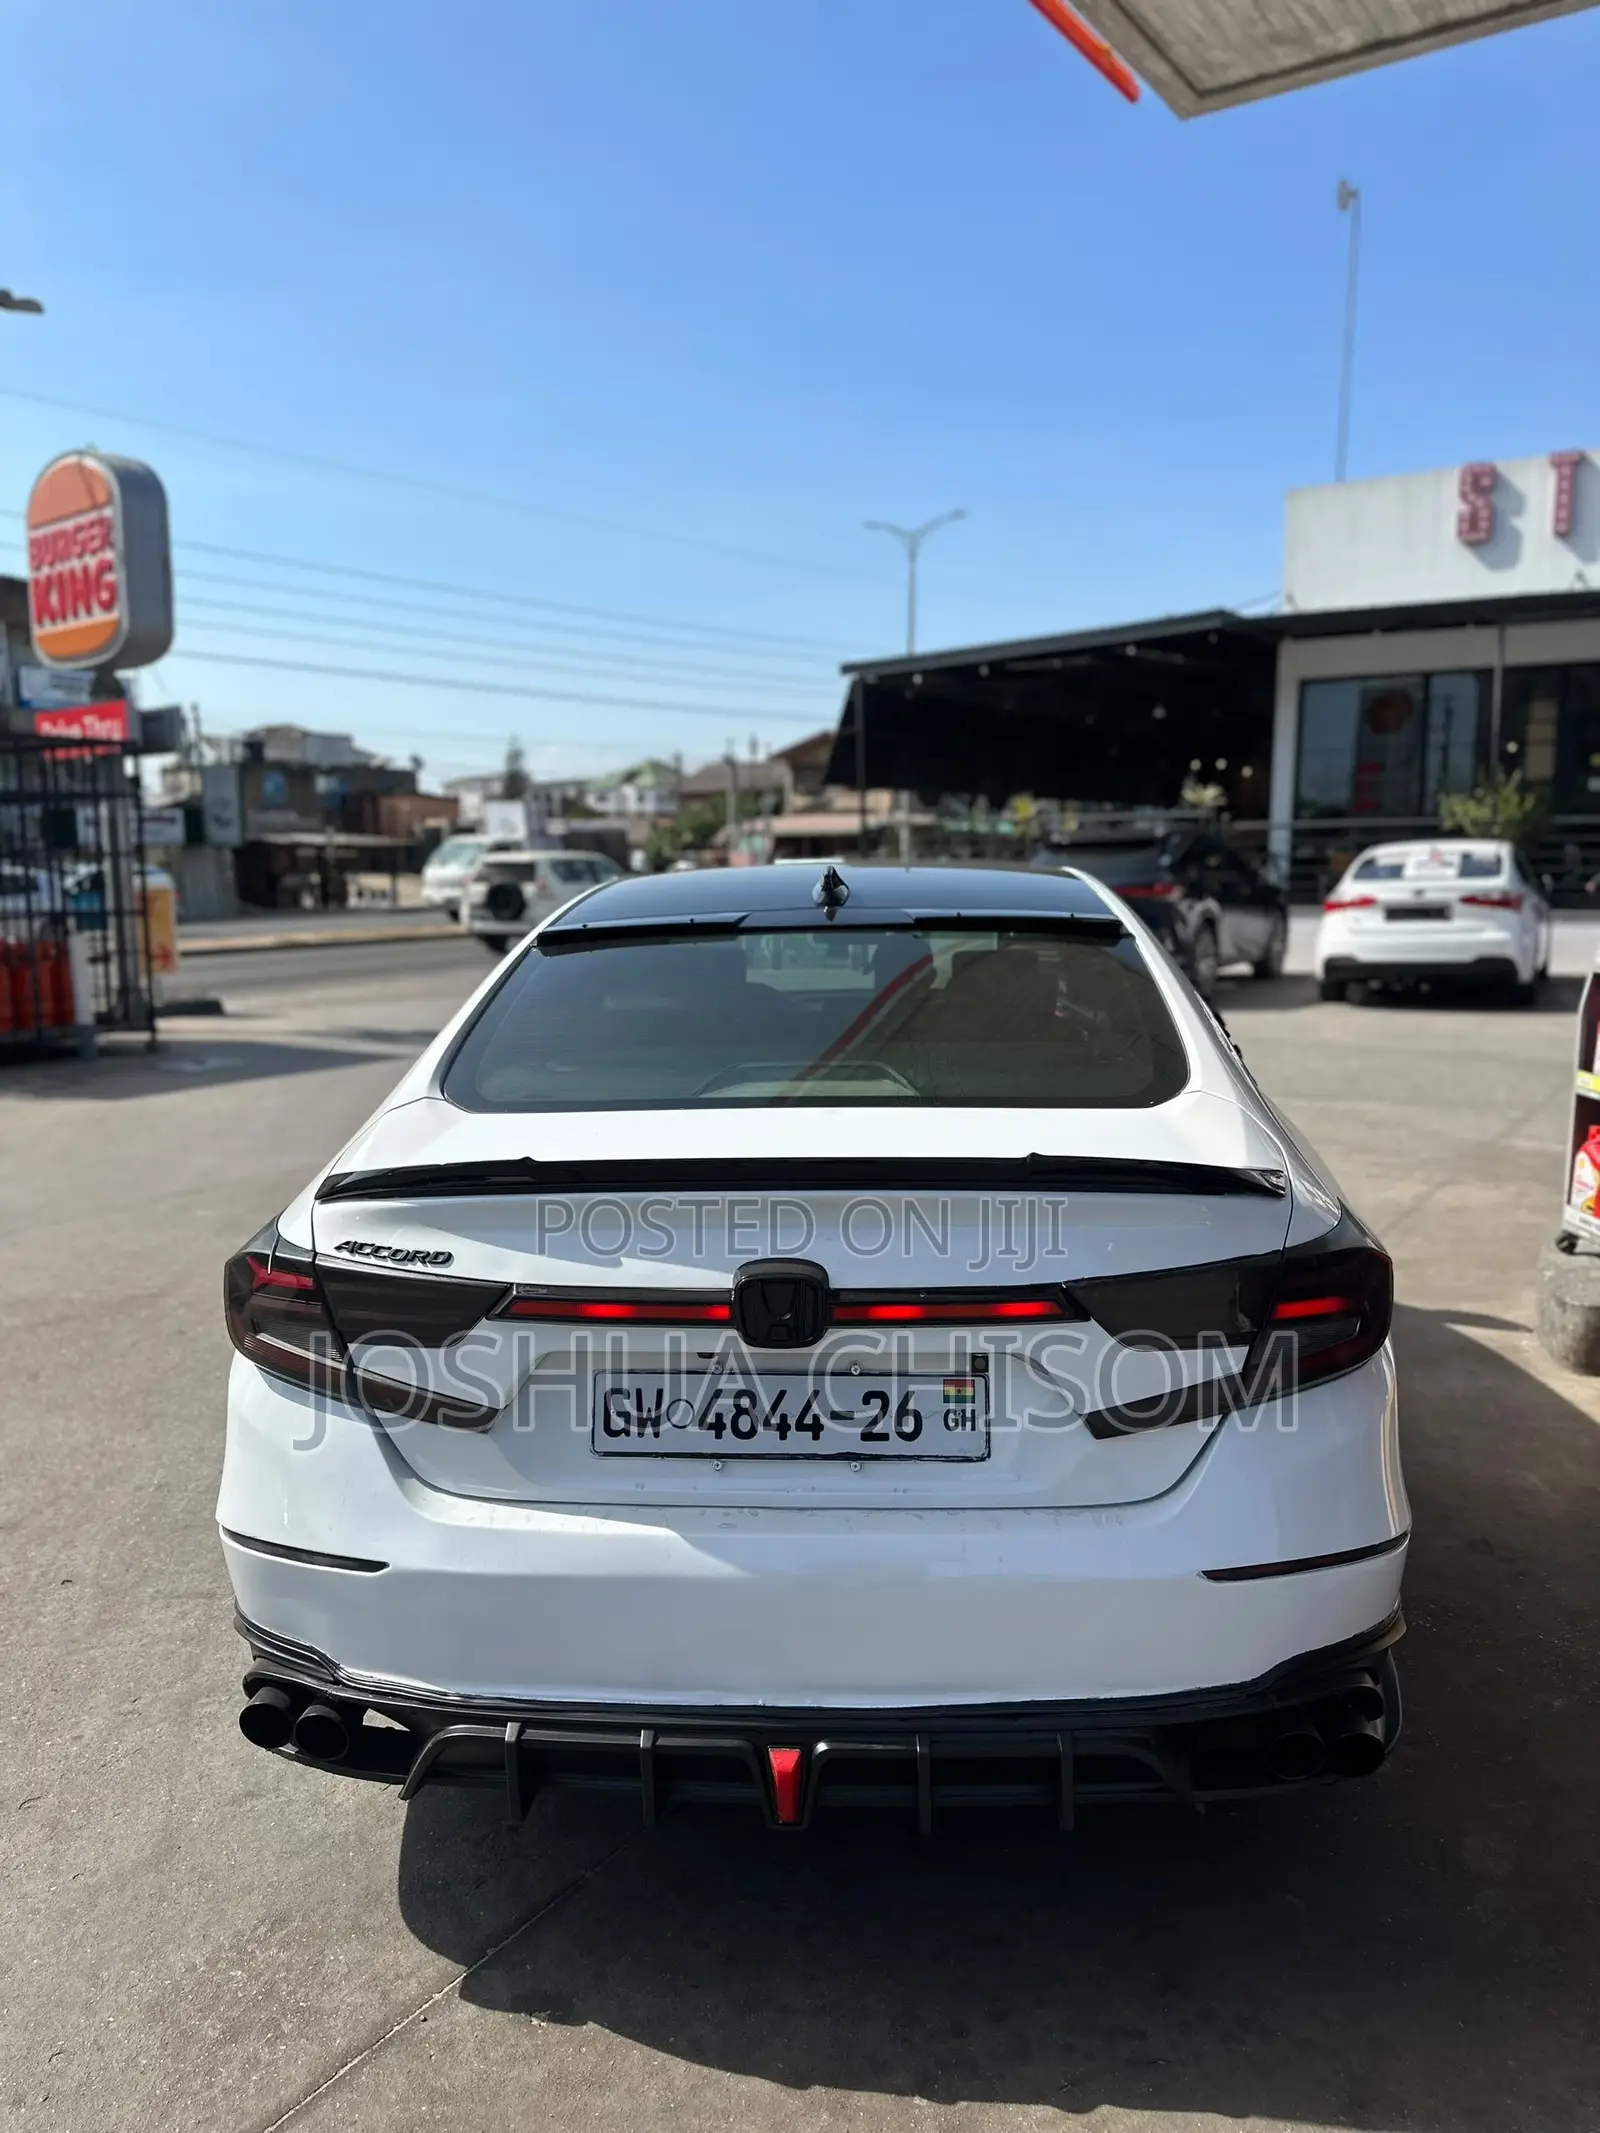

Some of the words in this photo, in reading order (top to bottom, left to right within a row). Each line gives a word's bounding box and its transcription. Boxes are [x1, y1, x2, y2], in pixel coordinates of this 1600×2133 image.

[30, 517, 115, 565] BURGER
[33, 559, 117, 627] KING
[333, 1240, 453, 1268] ACCORD
[602, 1387, 664, 1439] GW
[942, 1408, 977, 1432] GH
